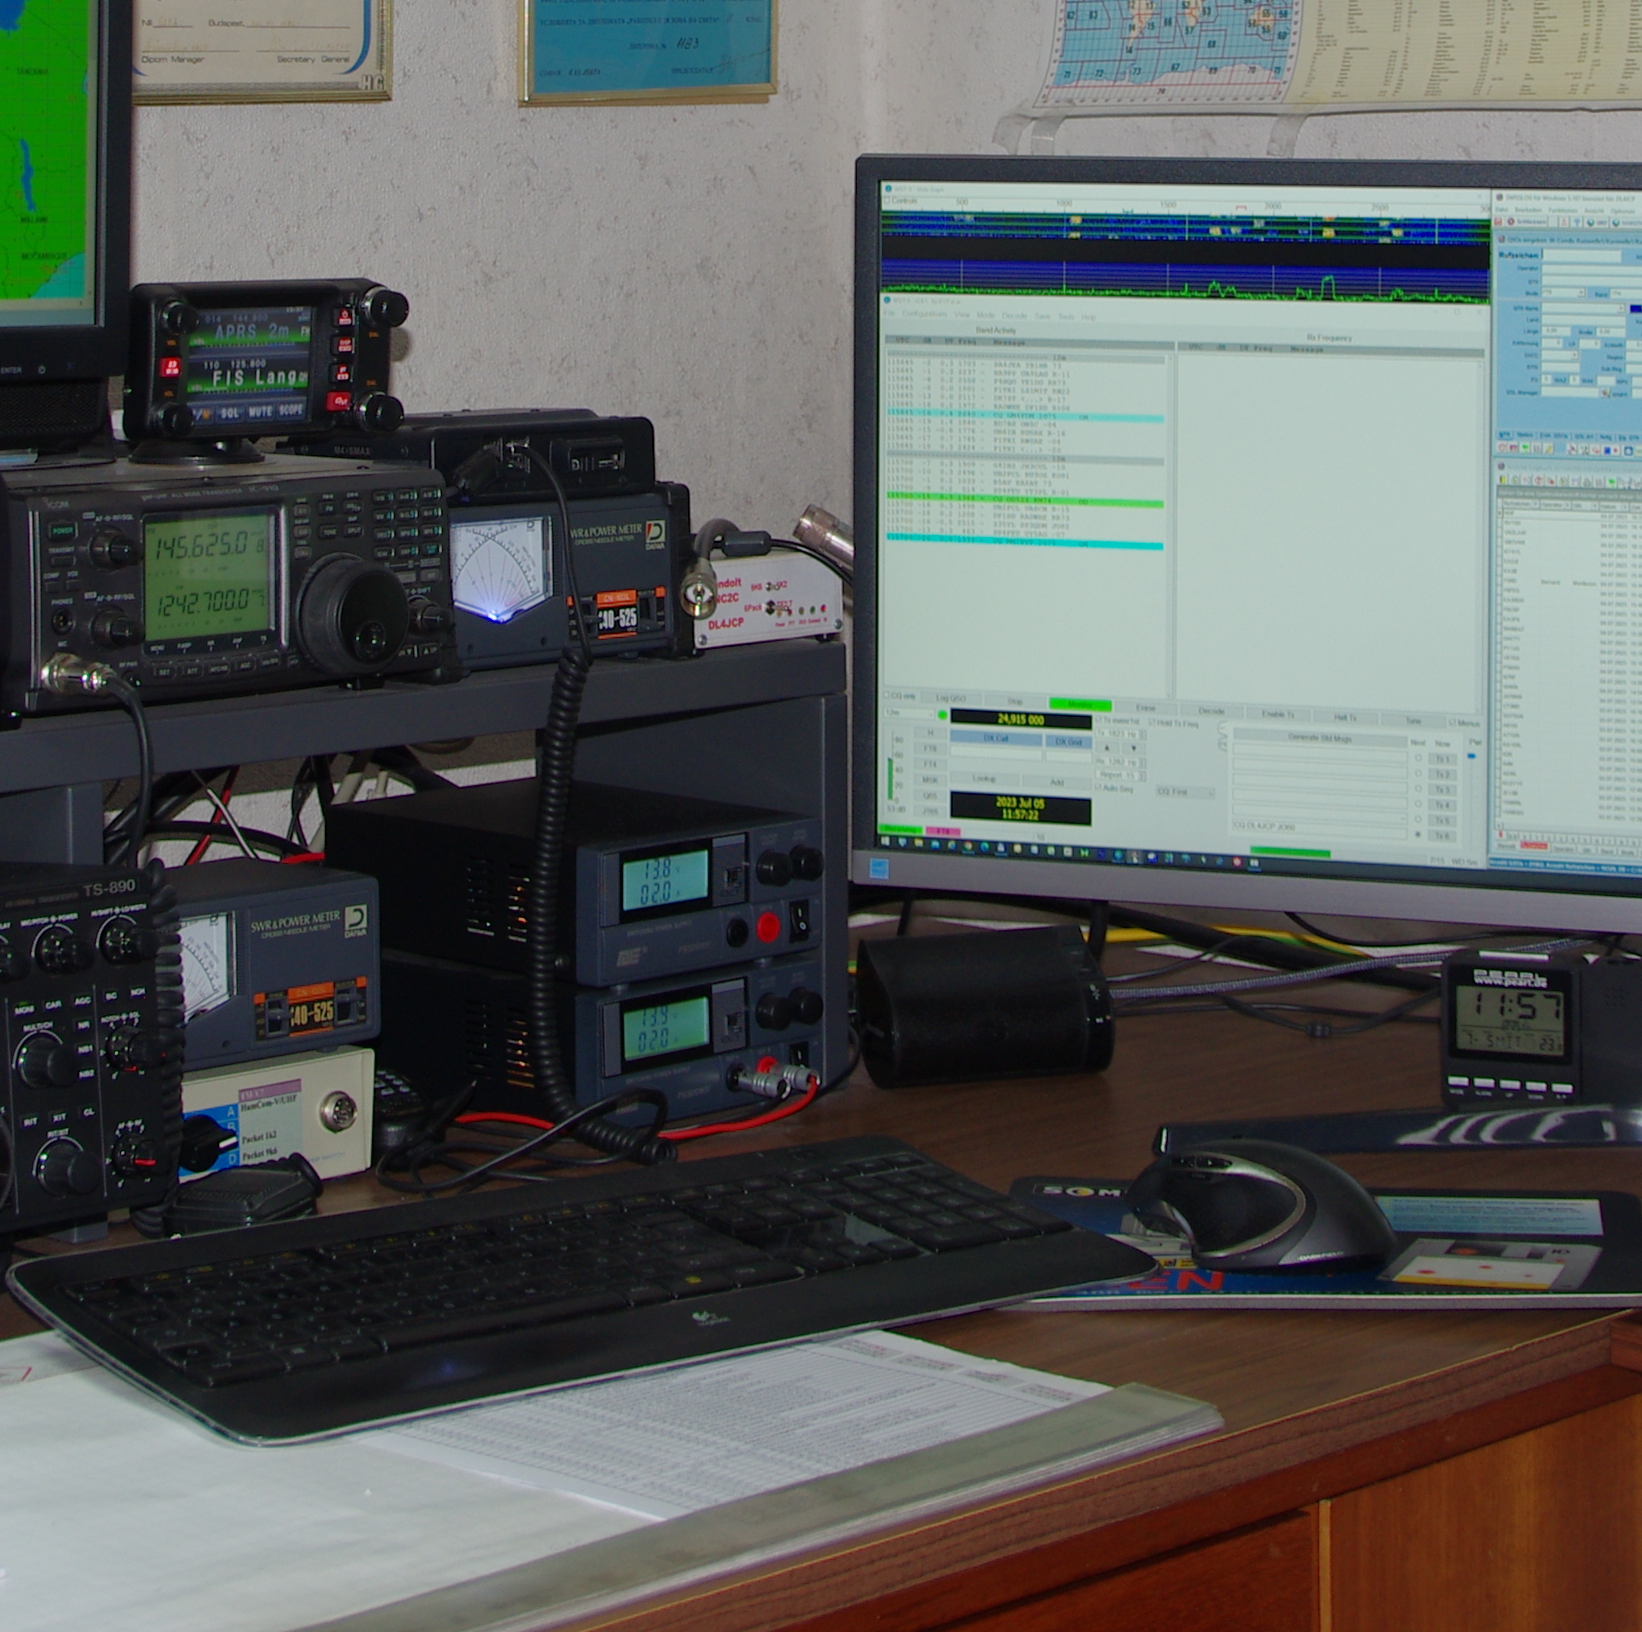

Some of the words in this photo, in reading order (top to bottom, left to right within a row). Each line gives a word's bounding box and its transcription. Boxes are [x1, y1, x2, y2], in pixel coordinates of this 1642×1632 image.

[141, 56, 167, 64] Diplom
[171, 56, 205, 64] Manager
[277, 55, 315, 64] Secretary
[216, 324, 257, 340] APRS
[269, 324, 289, 338] 2m
[213, 370, 244, 386] FIS
[256, 369, 295, 385] Lang
[221, 408, 239, 418] SQL
[249, 406, 272, 417] MUTE
[279, 404, 303, 415] SCOPE
[709, 618, 744, 630] DL4JCP
[996, 796, 1015, 808] 2023
[1017, 797, 1032, 808] Jul
[83, 879, 136, 897] TS-890
[314, 910, 340, 923] METER
[1474, 975, 1548, 988] www.pearl.de
[1474, 991, 1561, 1019] 11:57
